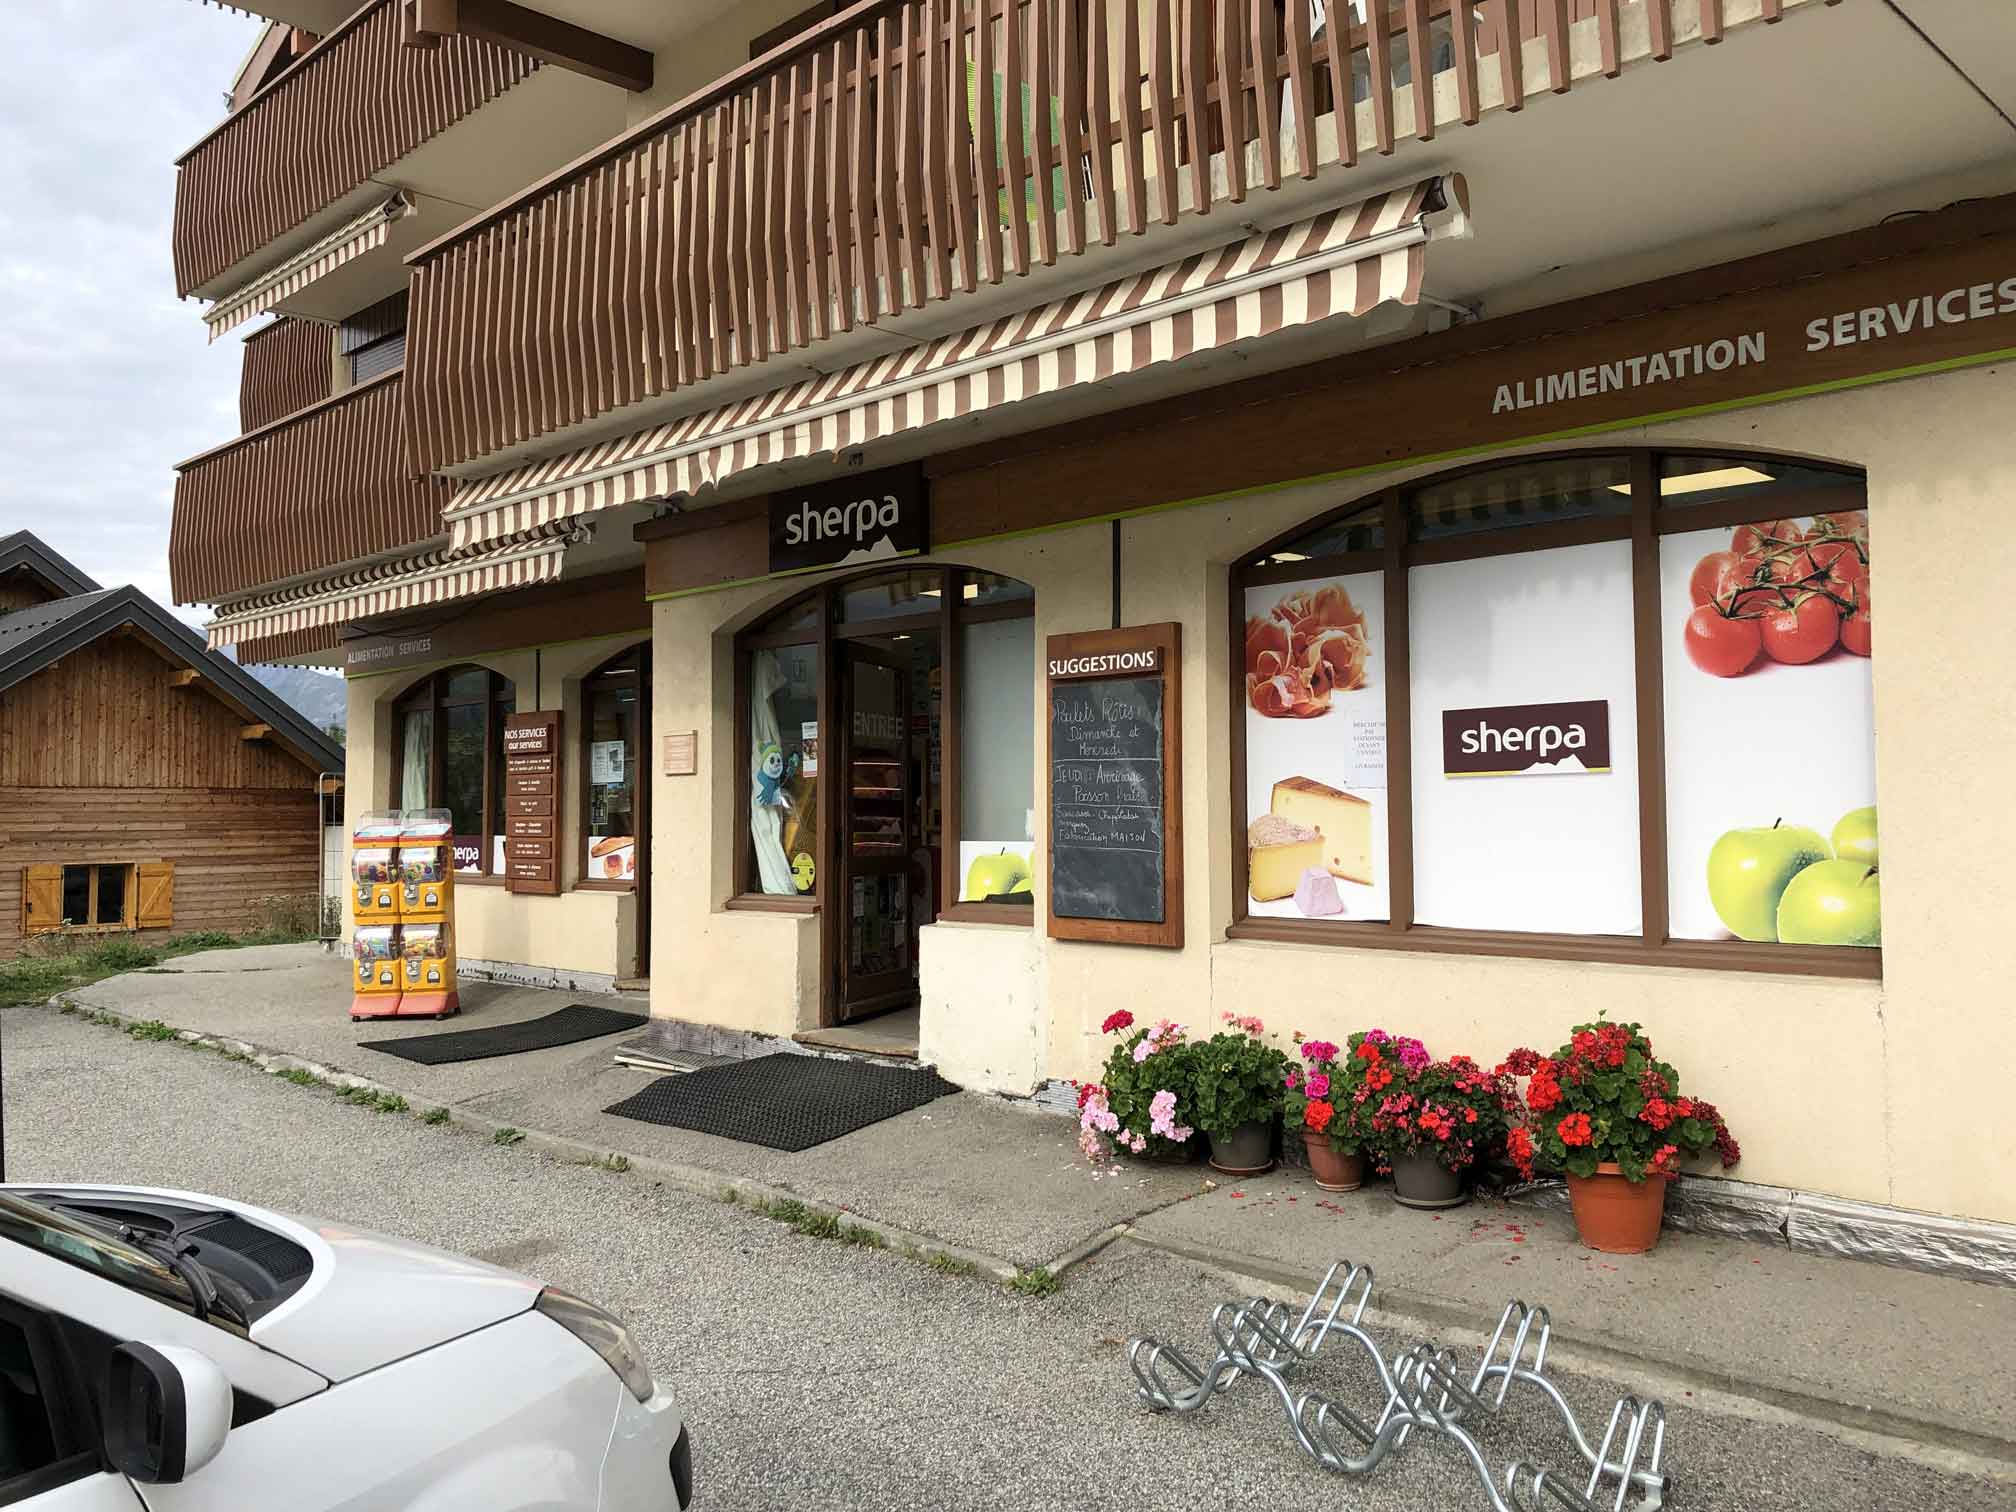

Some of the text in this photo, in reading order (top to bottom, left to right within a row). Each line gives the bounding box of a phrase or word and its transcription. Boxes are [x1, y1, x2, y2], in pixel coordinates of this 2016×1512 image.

[1491, 277, 2016, 415] ALIMENTATION SERVICES
[785, 495, 899, 545] sherpa
[347, 637, 432, 665] ALIMENTATION SERVICES
[1048, 650, 1155, 676] SUGGESTIONS
[504, 727, 547, 740] NOS SERVICES
[508, 740, 543, 751] our services
[1072, 784, 1110, 802] Poisson
[1110, 829, 1146, 843] MAISON
